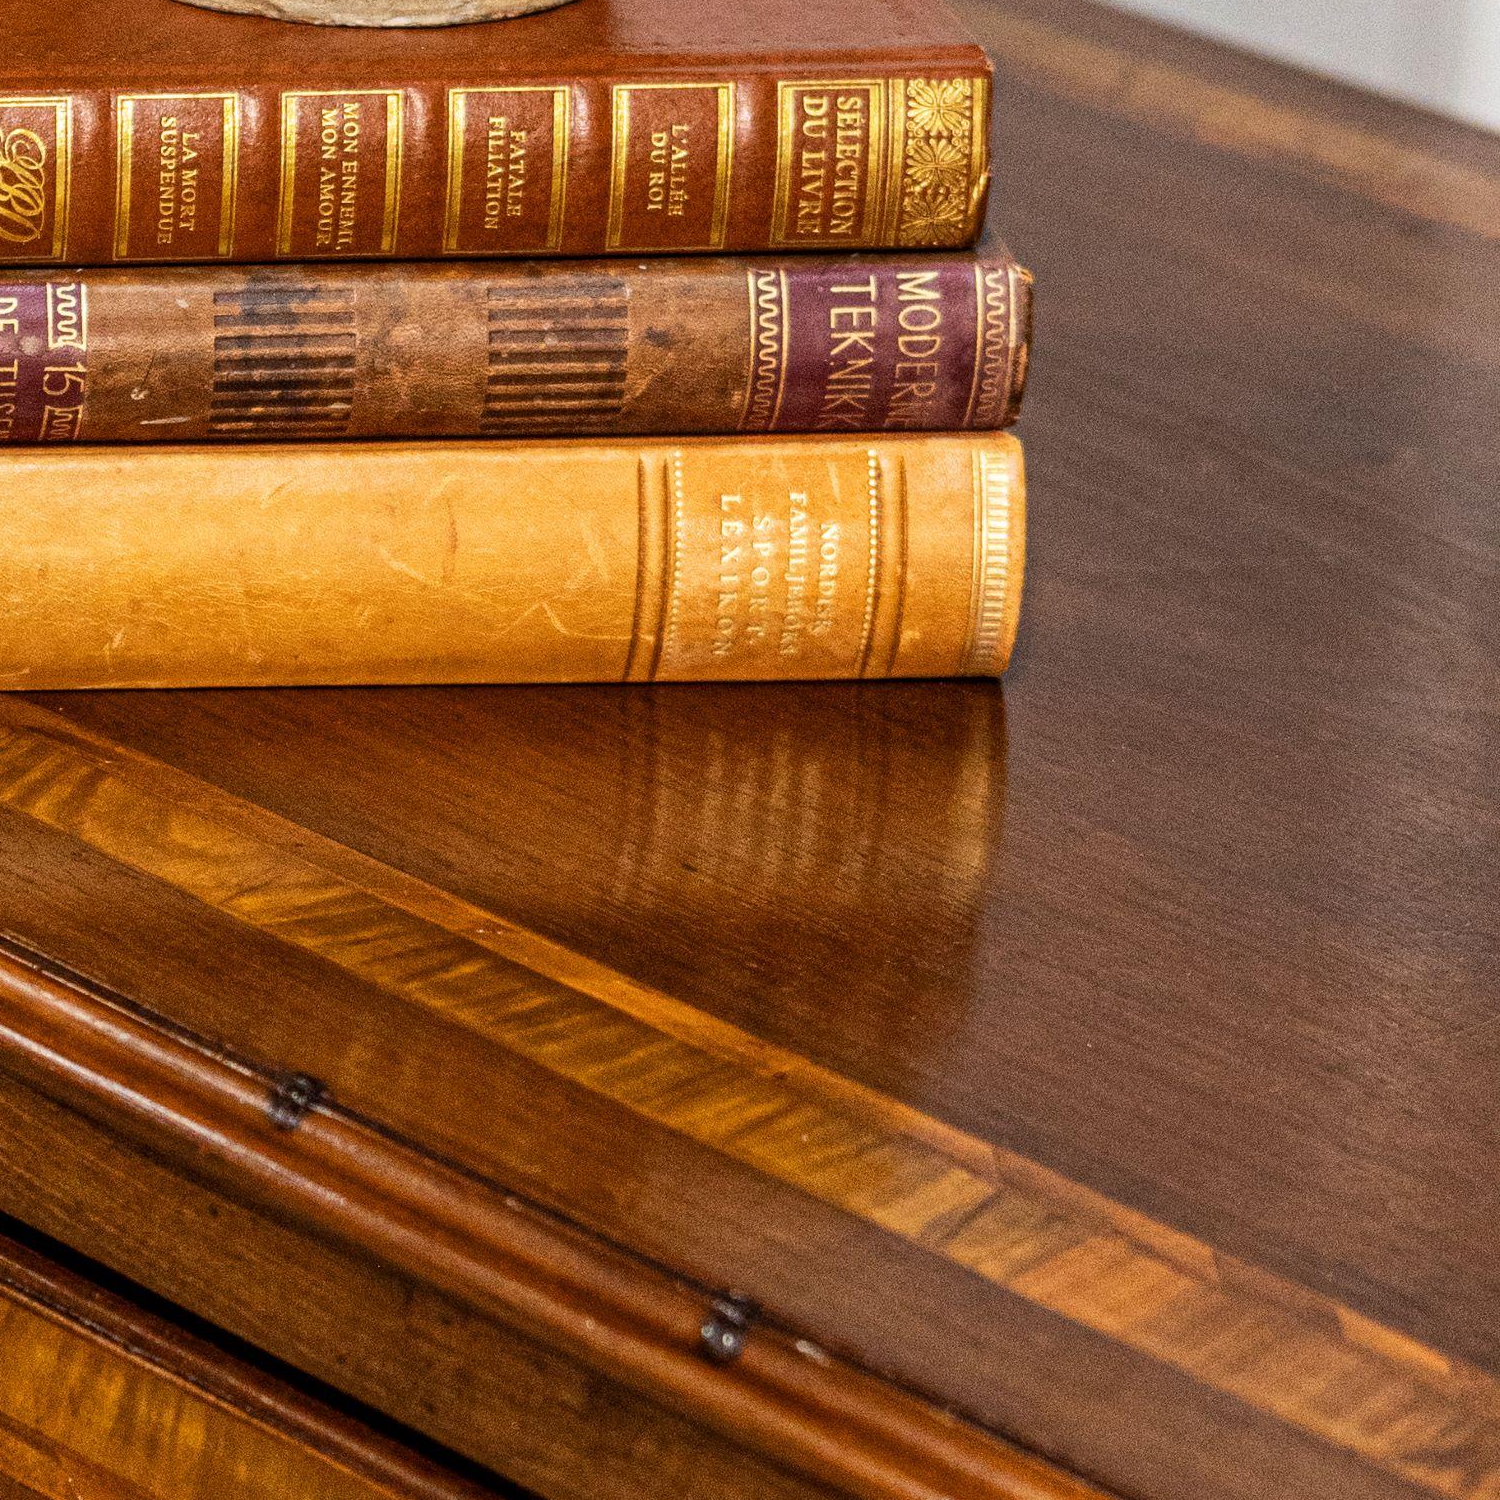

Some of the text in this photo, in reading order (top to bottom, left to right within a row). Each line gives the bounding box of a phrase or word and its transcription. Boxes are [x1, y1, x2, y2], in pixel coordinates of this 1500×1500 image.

[156, 116, 177, 245] SUSPENDUE
[178, 132, 199, 232] LA MORT
[315, 108, 338, 247] MON AMOUR
[334, 102, 360, 251] MON ENNEMI,
[484, 115, 505, 230] FILIATION
[506, 130, 526, 217] FATALE
[646, 132, 667, 211] DU ROI
[667, 124, 691, 217] L'ALLÉE
[795, 95, 829, 234] DU LIVRE
[829, 95, 867, 235] SÉLECTION
[42, 361, 87, 397] 15
